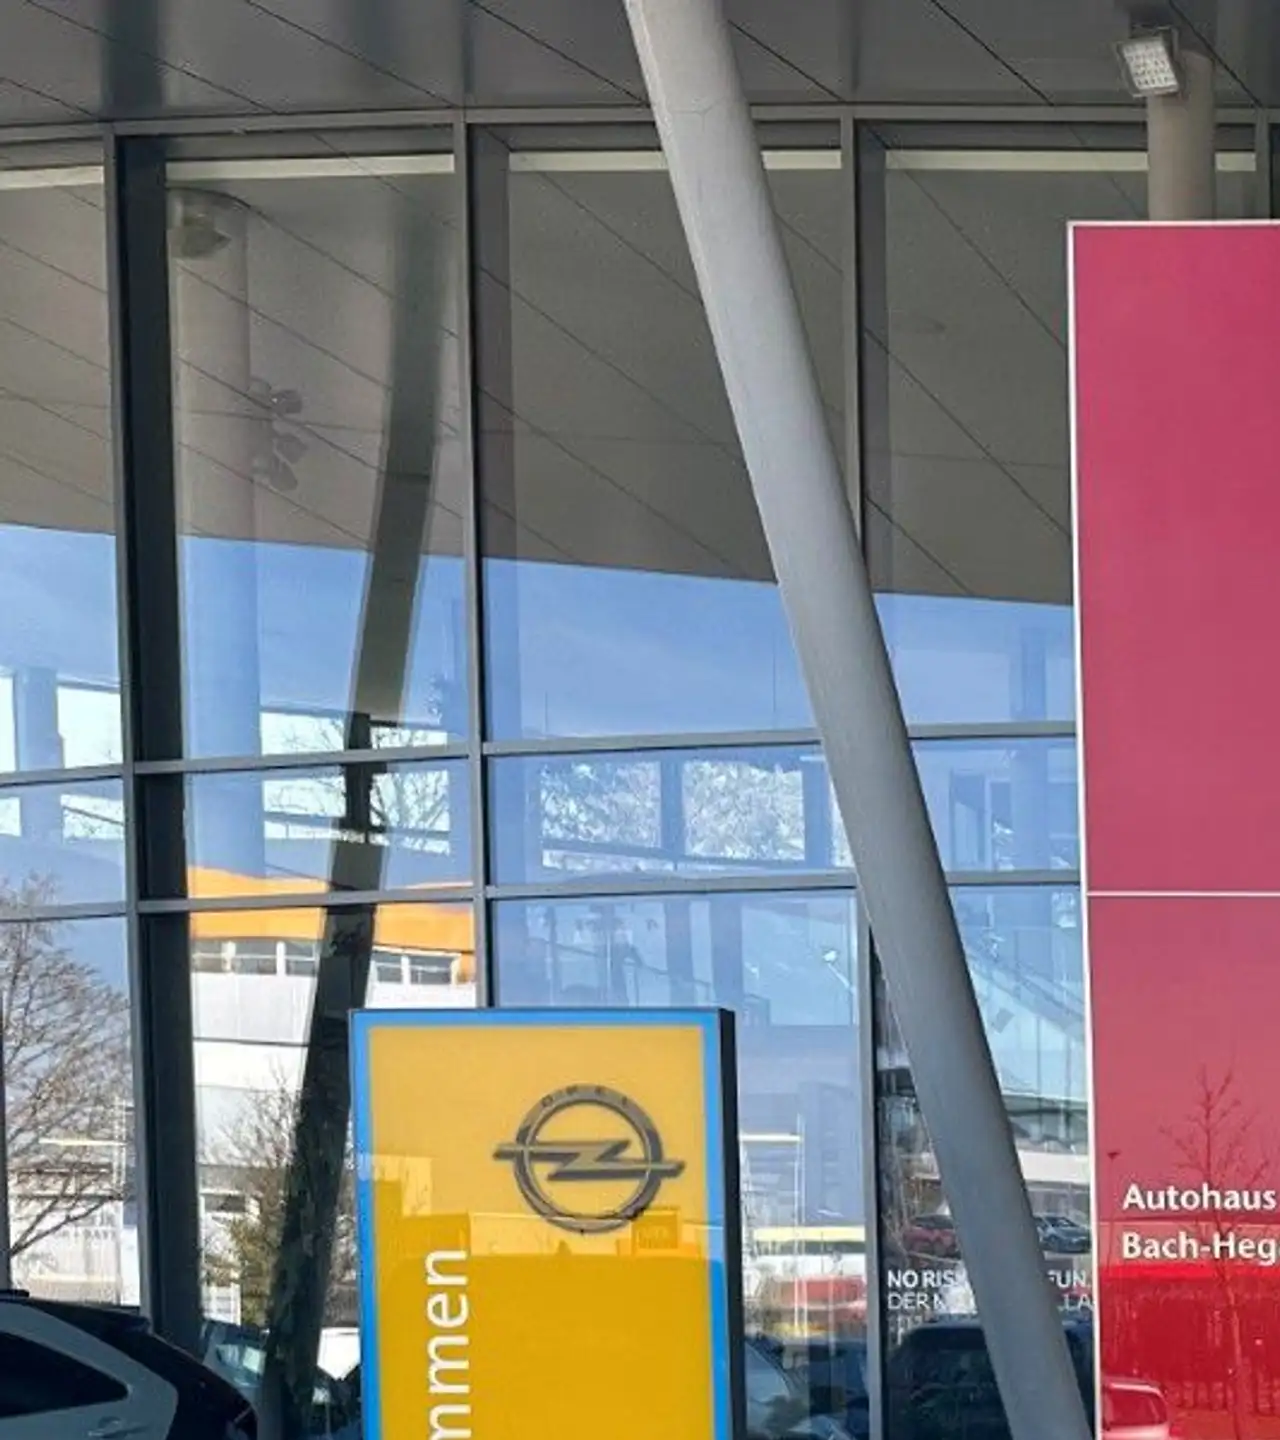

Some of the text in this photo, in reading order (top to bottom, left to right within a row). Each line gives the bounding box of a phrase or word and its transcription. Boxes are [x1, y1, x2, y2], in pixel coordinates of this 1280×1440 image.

[1122, 1183, 1276, 1210] Autohaus
[887, 1269, 917, 1288] NO
[887, 1294, 928, 1311] DER
